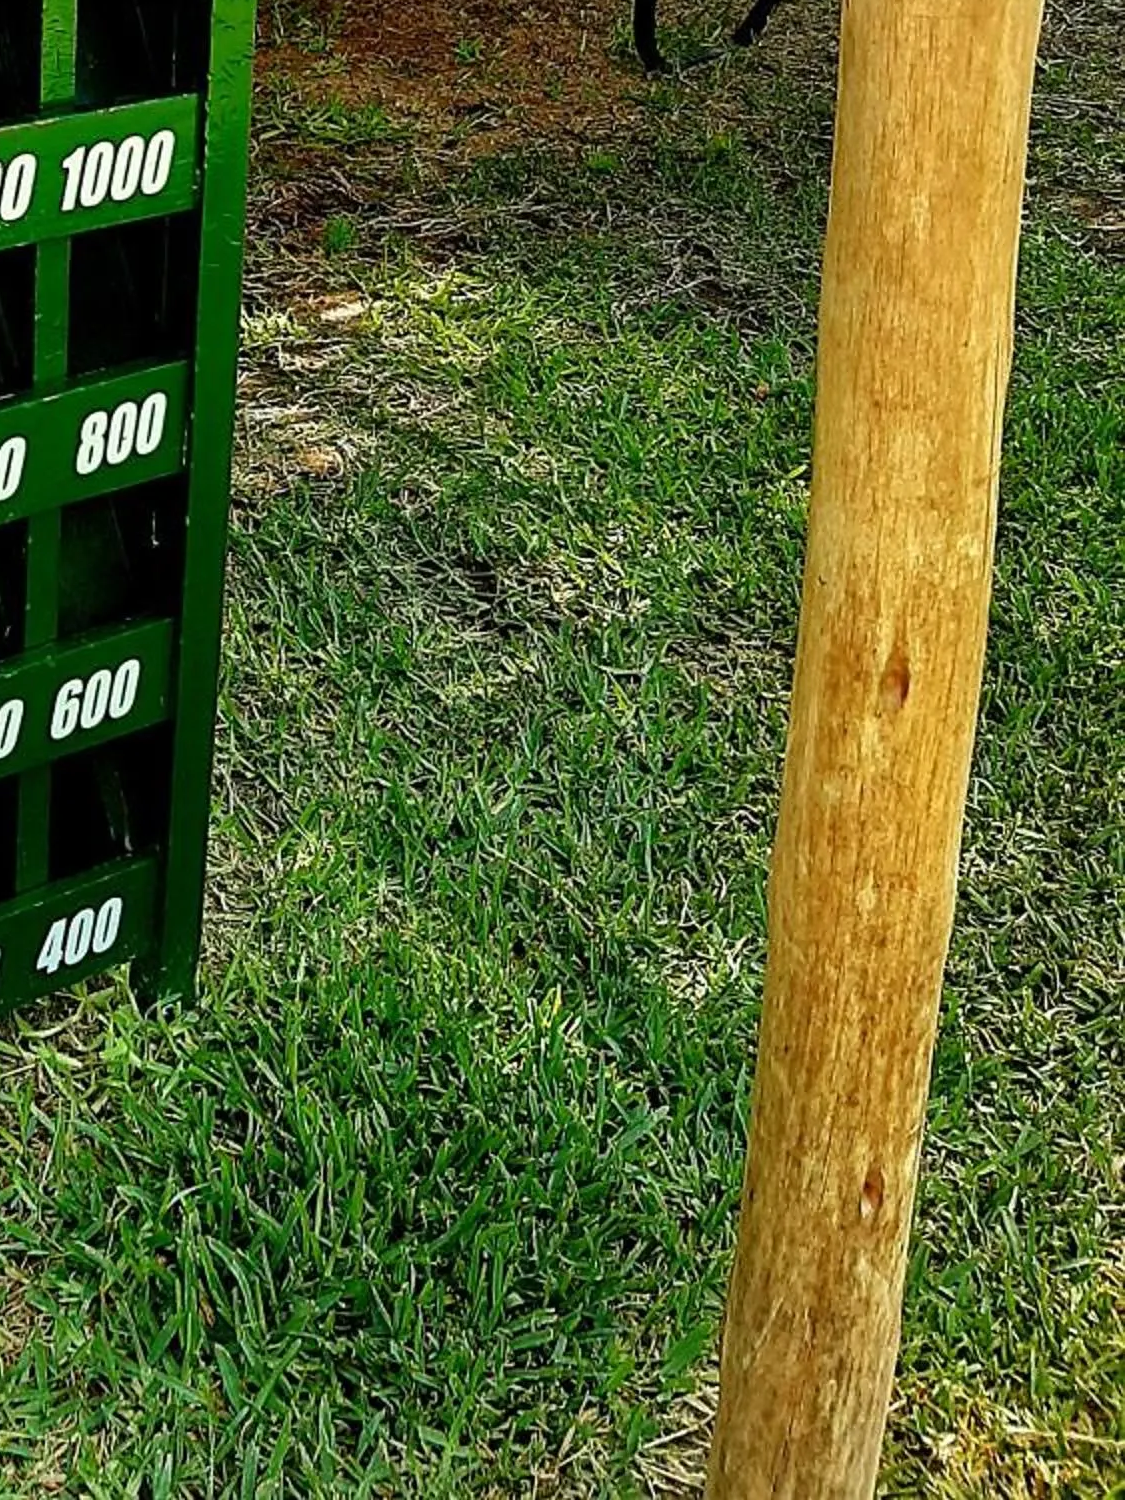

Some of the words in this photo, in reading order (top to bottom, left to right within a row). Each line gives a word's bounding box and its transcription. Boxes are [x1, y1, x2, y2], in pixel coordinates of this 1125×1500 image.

[60, 129, 176, 212] 1000
[75, 391, 168, 476] 800
[49, 658, 141, 740] 600
[35, 896, 123, 975] 400
